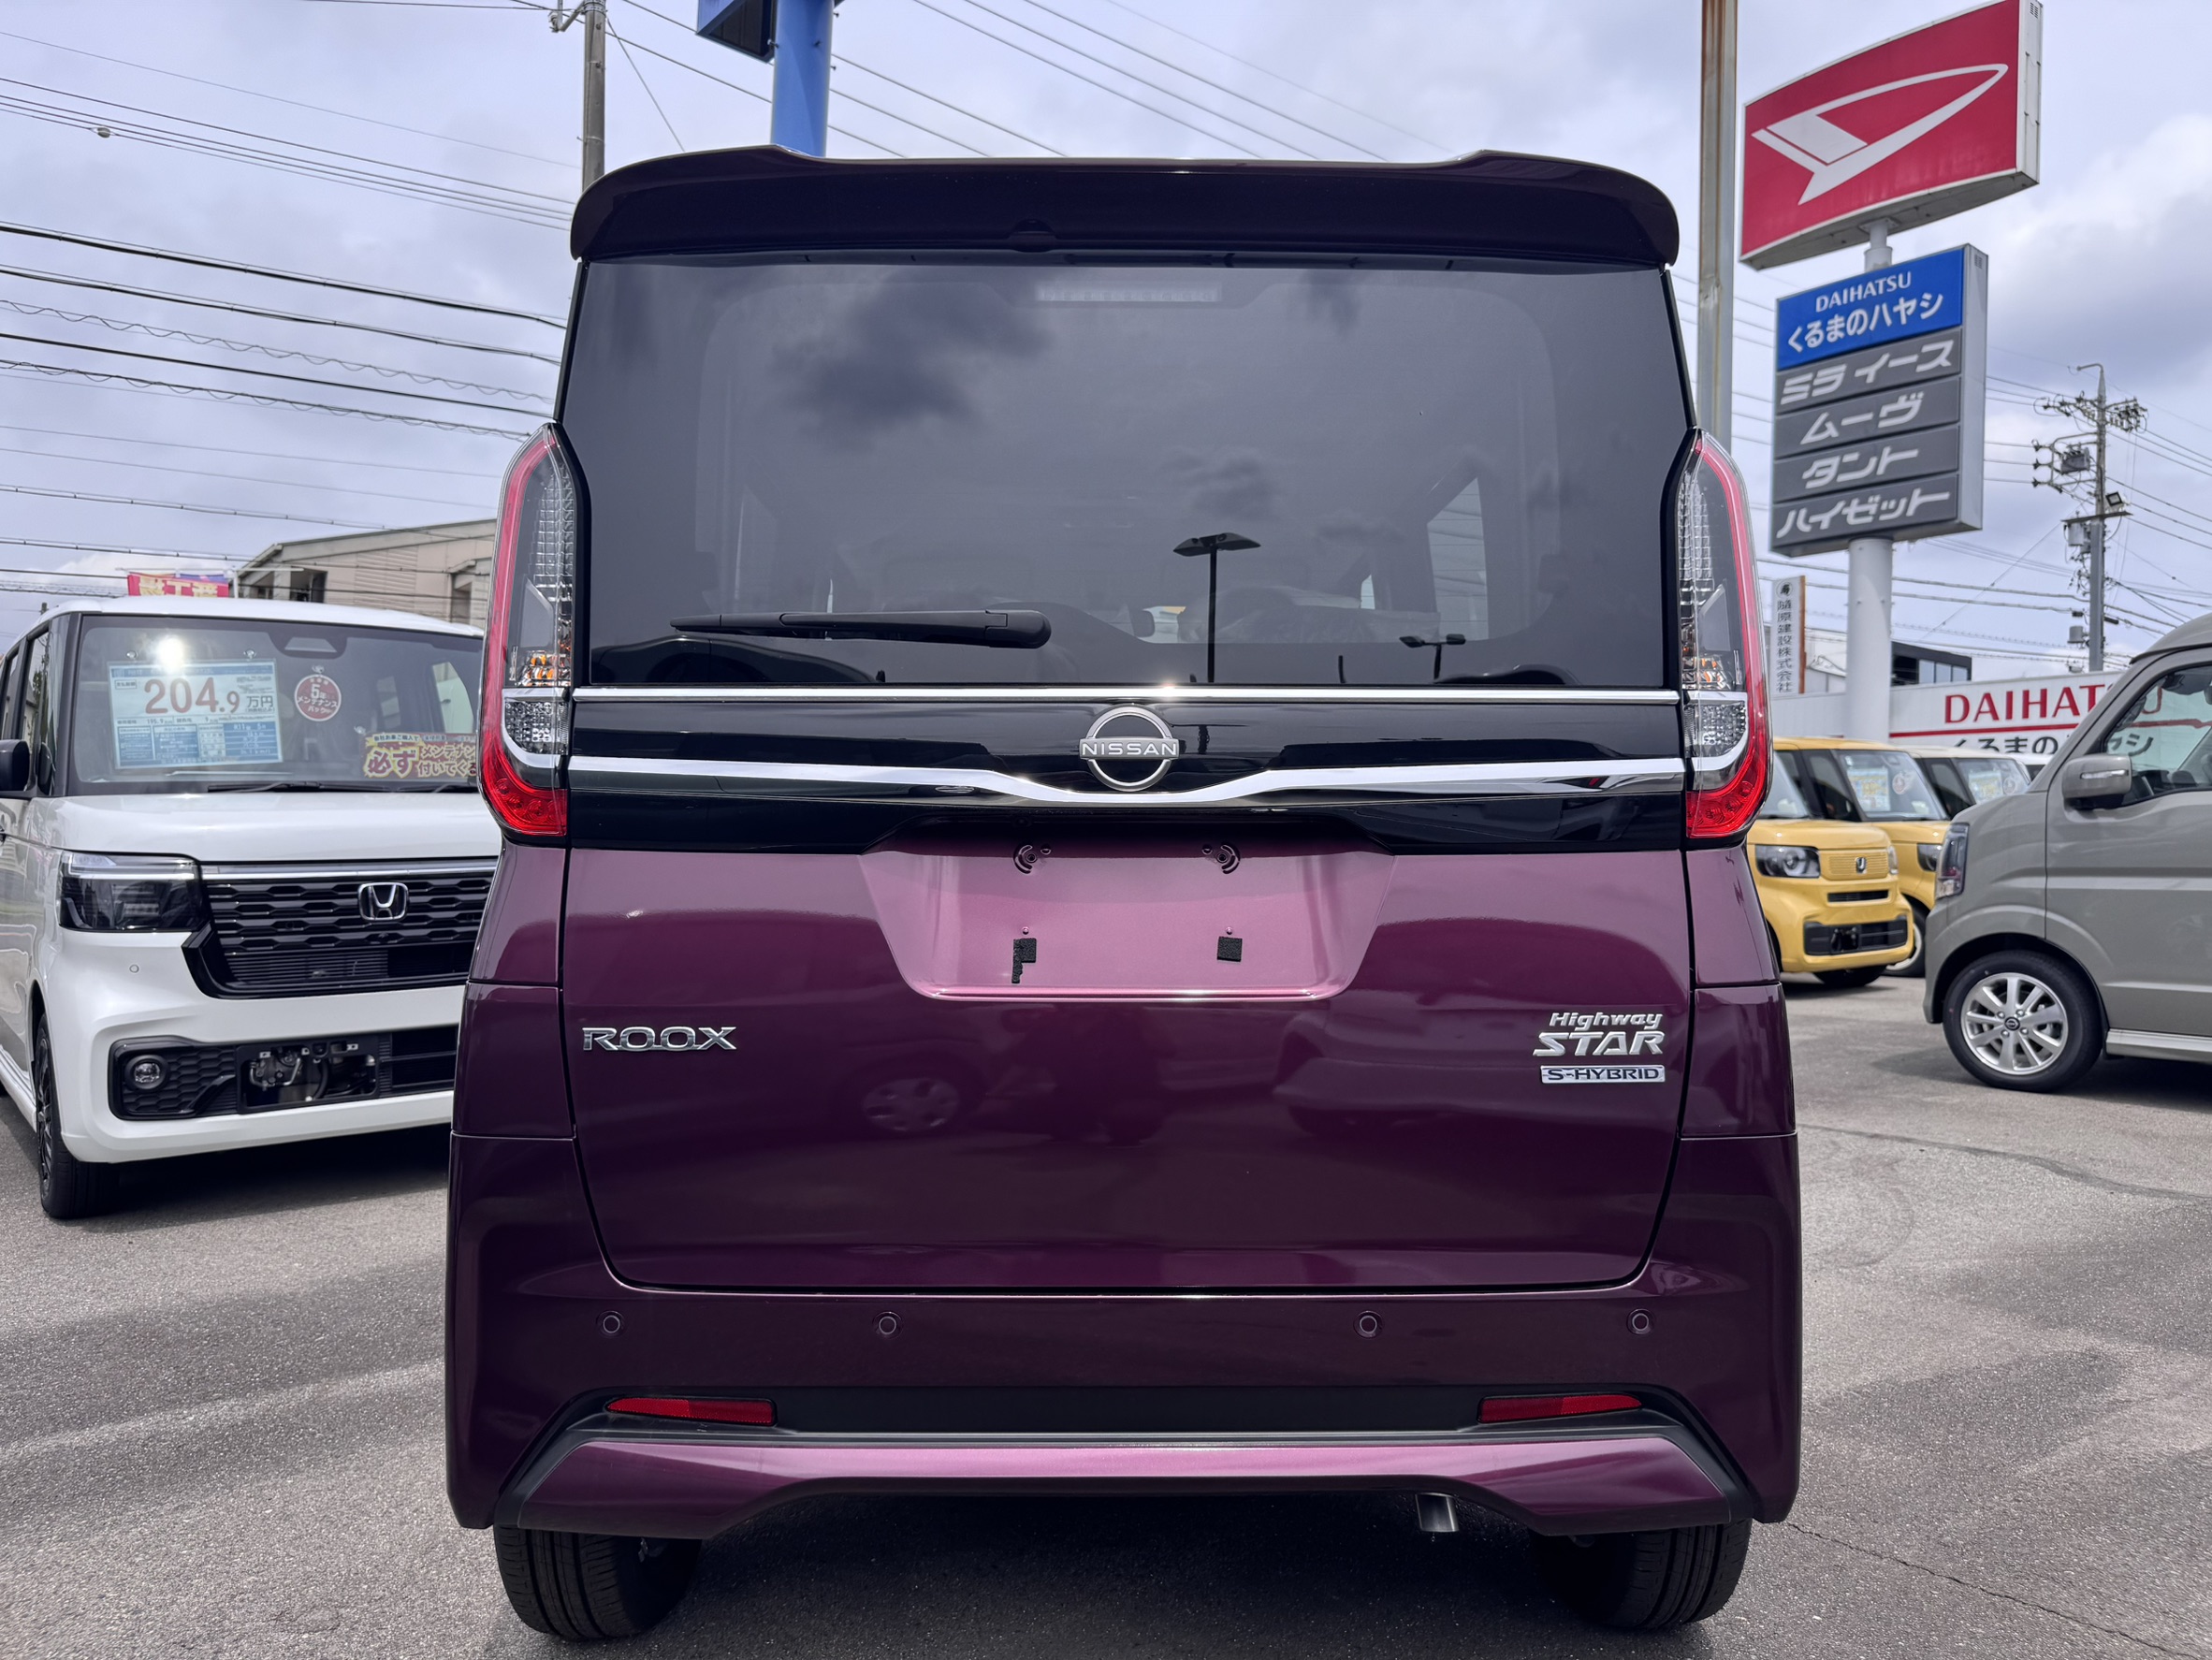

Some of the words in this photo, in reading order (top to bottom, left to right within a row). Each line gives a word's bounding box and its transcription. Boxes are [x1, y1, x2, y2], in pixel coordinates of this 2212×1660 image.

[1815, 270, 1912, 313] DAIHATSU
[1788, 292, 1943, 353] くるまのハヤシ
[1800, 391, 1924, 444] ムーヴ
[1802, 446, 1919, 488] タント
[1776, 488, 1950, 538] ハイゼット
[144, 677, 240, 714] 204.9
[246, 695, 274, 708] 万円
[298, 695, 338, 708] メンテナンス
[1944, 684, 2162, 724] DAIHATU
[368, 750, 416, 775] 必ず
[1082, 743, 1177, 756] NISSAN
[1549, 1012, 1664, 1031] Highway
[582, 1026, 737, 1052] ROOX
[1533, 1030, 1666, 1056] STAR
[1548, 1069, 1660, 1081] S-HYBRID
